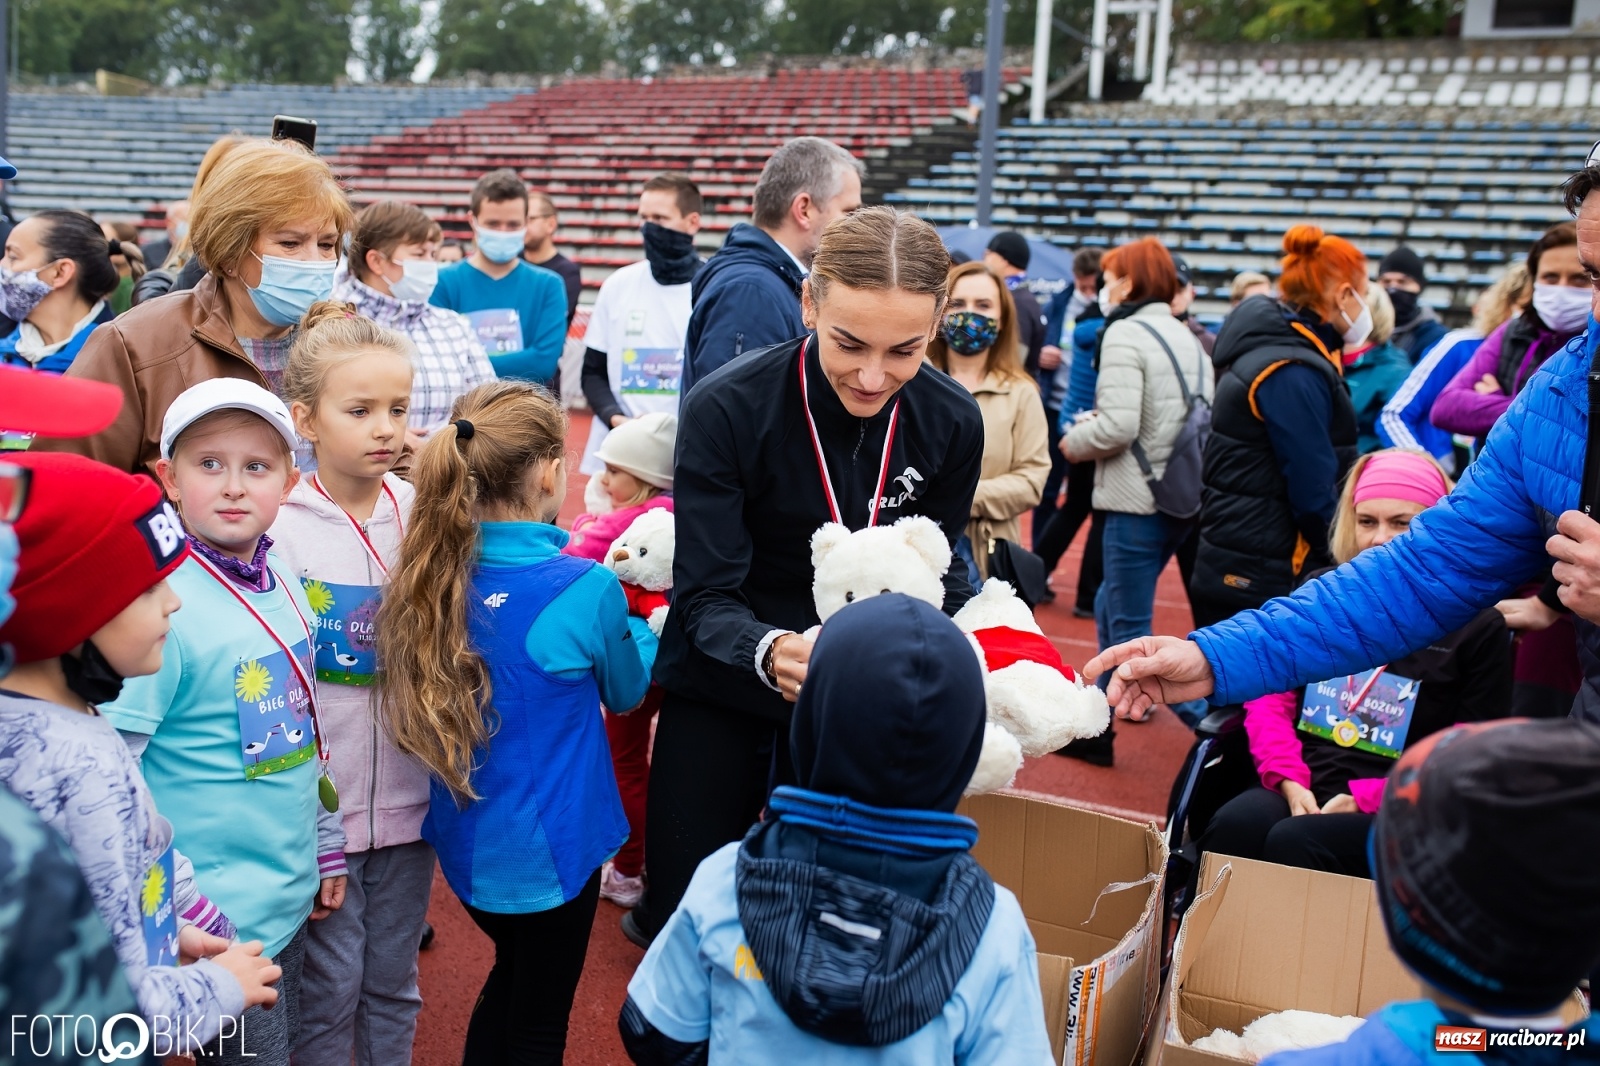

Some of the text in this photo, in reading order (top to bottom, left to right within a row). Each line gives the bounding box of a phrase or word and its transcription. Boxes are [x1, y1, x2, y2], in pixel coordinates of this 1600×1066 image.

[483, 592, 509, 608] 4F
[316, 617, 342, 631] BIEG
[1317, 684, 1337, 699] BIEG
[259, 695, 285, 715] BIEG
[1358, 723, 1395, 747] 214
